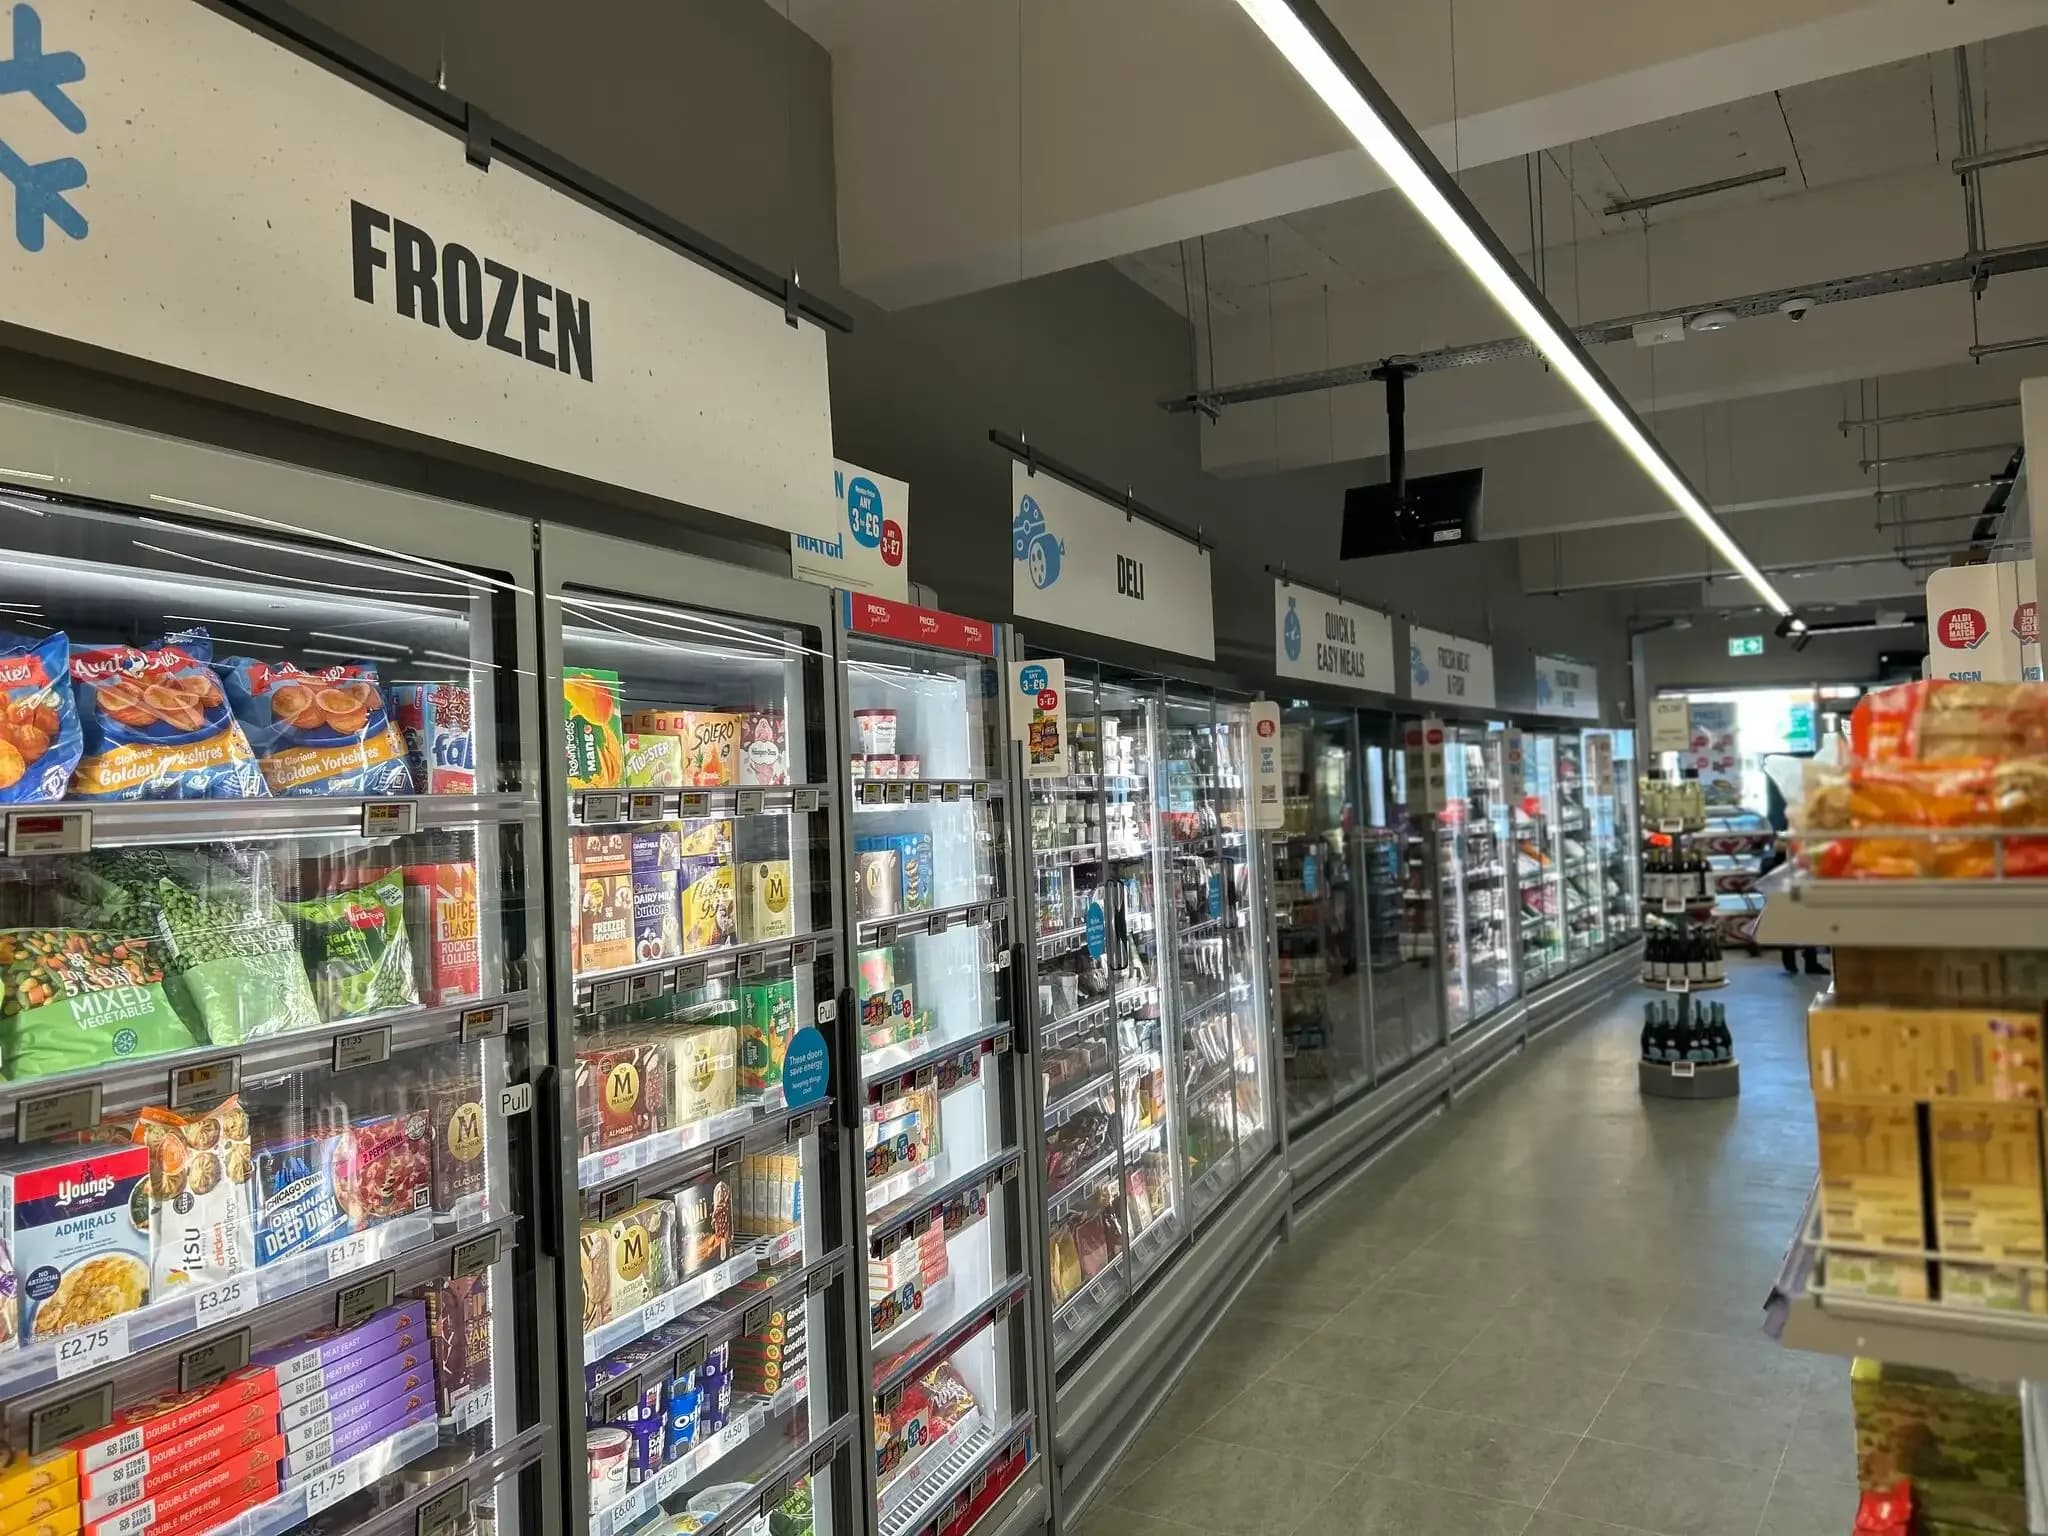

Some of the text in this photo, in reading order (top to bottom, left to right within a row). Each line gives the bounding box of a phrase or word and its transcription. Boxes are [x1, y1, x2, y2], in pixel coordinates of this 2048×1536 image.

[350, 200, 594, 383] FROZEN
[860, 496, 871, 510] ANY
[853, 508, 859, 532] 3
[866, 512, 879, 538] £6
[883, 537, 900, 556] 3 £7
[1117, 554, 1145, 600] DELI
[867, 604, 886, 616] PRICES
[1951, 614, 1972, 622] ALDI
[920, 615, 935, 627] PRICES
[1325, 612, 1356, 645] QUICK &
[1949, 621, 1976, 631] PRICE
[1949, 629, 1976, 638] MATCH
[75, 653, 123, 678] Aunt
[1317, 643, 1365, 678] EASY MEALS
[1023, 679, 1045, 691] 3 £6
[1949, 671, 1982, 682] SIGN
[1040, 698, 1055, 706] 3 £7
[692, 719, 734, 751] SOLERO
[285, 751, 317, 767] Glorious
[100, 761, 155, 787] Golden
[277, 763, 322, 785] Golden
[633, 890, 676, 905] DAIRY MILK
[769, 878, 784, 899] M
[634, 903, 671, 919] buttons
[442, 920, 475, 938] BLAST
[593, 919, 626, 934] FREEZER
[441, 940, 476, 955] ROCKET
[441, 952, 477, 967] LOLLIES
[64, 980, 78, 997] 5
[100, 973, 135, 989] DAY
[69, 985, 152, 1020] MIXED
[820, 1004, 835, 1020] Pull
[78, 1001, 155, 1031] VEGETABLES
[789, 1049, 823, 1066] These doors
[789, 1060, 823, 1077] save energy
[614, 1071, 632, 1098] M
[502, 1086, 529, 1114] Pull
[611, 1094, 634, 1105] MAGNUM
[457, 1115, 478, 1143] M
[608, 1125, 634, 1138] ALMOND
[363, 1132, 403, 1163] 2 PEPPERONI
[54, 1174, 116, 1208] Young's
[453, 1173, 482, 1189] CLASSIC
[266, 1173, 323, 1211] CHICAGO TOWN
[272, 1190, 329, 1228] ORIGINAL
[55, 1211, 117, 1238] ADMIRAL'S
[264, 1217, 304, 1257] DEEP
[304, 1195, 338, 1233] DISH
[79, 1230, 95, 1242] PIE
[183, 1228, 203, 1271] itsu
[330, 1239, 365, 1263] £1.75
[624, 1233, 643, 1267] M
[38, 1270, 49, 1278] NO
[200, 1283, 241, 1312] £3.25
[645, 1300, 666, 1321] £4.75
[60, 1329, 109, 1361] £2.75
[323, 1337, 360, 1358] MEAT FEAST
[326, 1358, 363, 1380] MEAT FEAST
[330, 1379, 366, 1402] MEAT FEAST
[334, 1400, 370, 1423] MEAT FEAST
[467, 1392, 489, 1414] £1.7
[146, 1402, 220, 1440] DOUBLE PEPPERONI
[119, 1432, 140, 1446] STONE
[336, 1421, 372, 1445] MEAT FEAST
[723, 1423, 742, 1442] £4.50
[119, 1440, 140, 1455] BAKED
[151, 1424, 225, 1465] DOUBLE PEPPERONI
[125, 1456, 146, 1470] STONE
[125, 1464, 146, 1478] BAKED
[146, 1449, 221, 1488] DOUBLE PEPPERONI
[119, 1481, 140, 1495] STONE
[310, 1469, 345, 1499] £1.75
[657, 1470, 678, 1490] £4.50
[120, 1489, 140, 1504] BAKED
[157, 1472, 230, 1512] DOUBLE PEPPERONI
[132, 1505, 152, 1520] STONE
[180, 1496, 221, 1523] PEPPERONI
[614, 1496, 636, 1521] £6.00
[132, 1513, 153, 1527] BAKED
